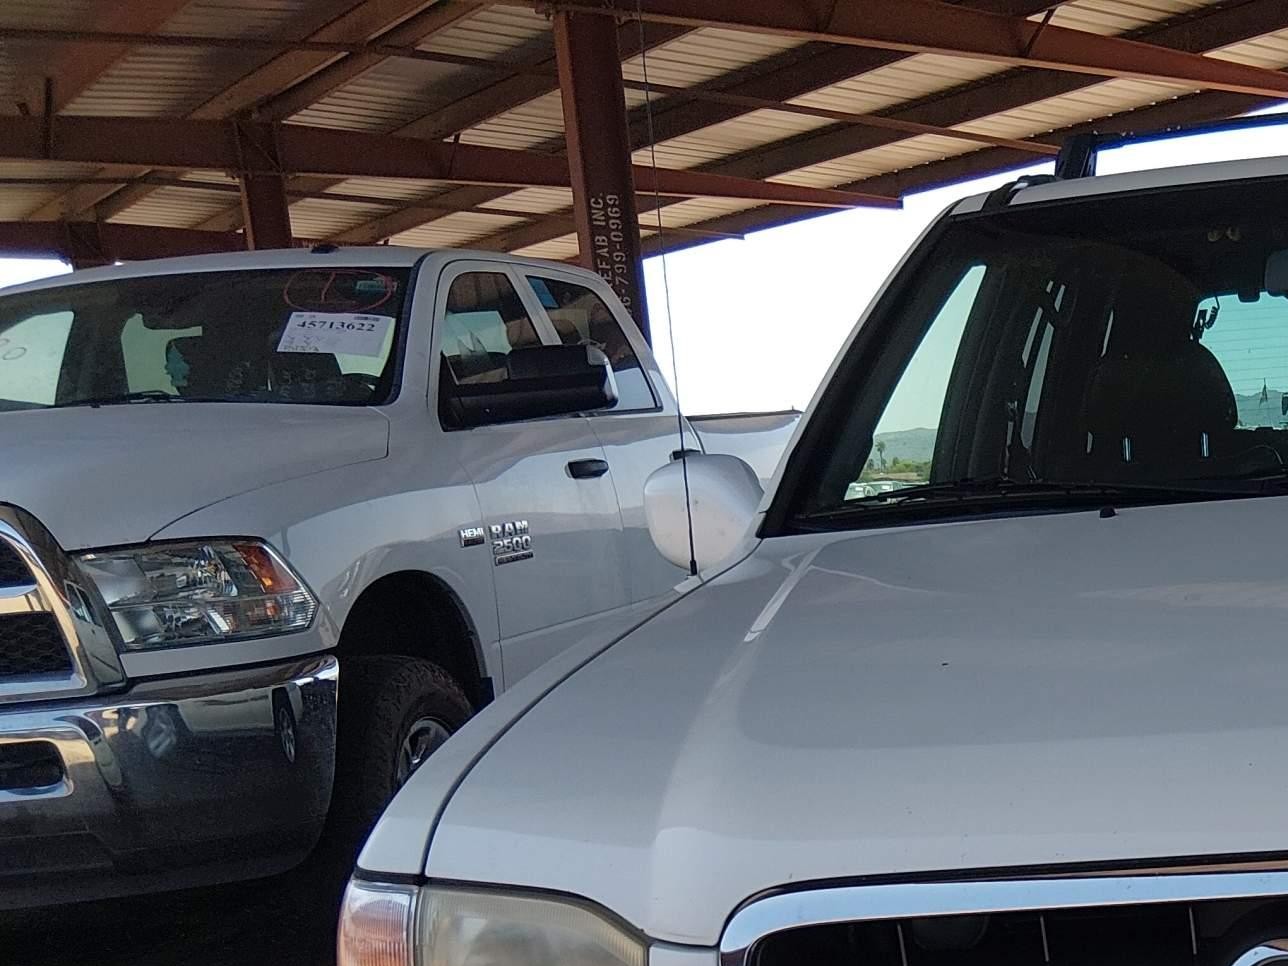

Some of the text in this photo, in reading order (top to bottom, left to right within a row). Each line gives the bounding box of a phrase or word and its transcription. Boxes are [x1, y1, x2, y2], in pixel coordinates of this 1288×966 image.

[296, 320, 376, 332] 45713622
[460, 520, 528, 538] HEMI RAM
[494, 535, 532, 555] 2500
